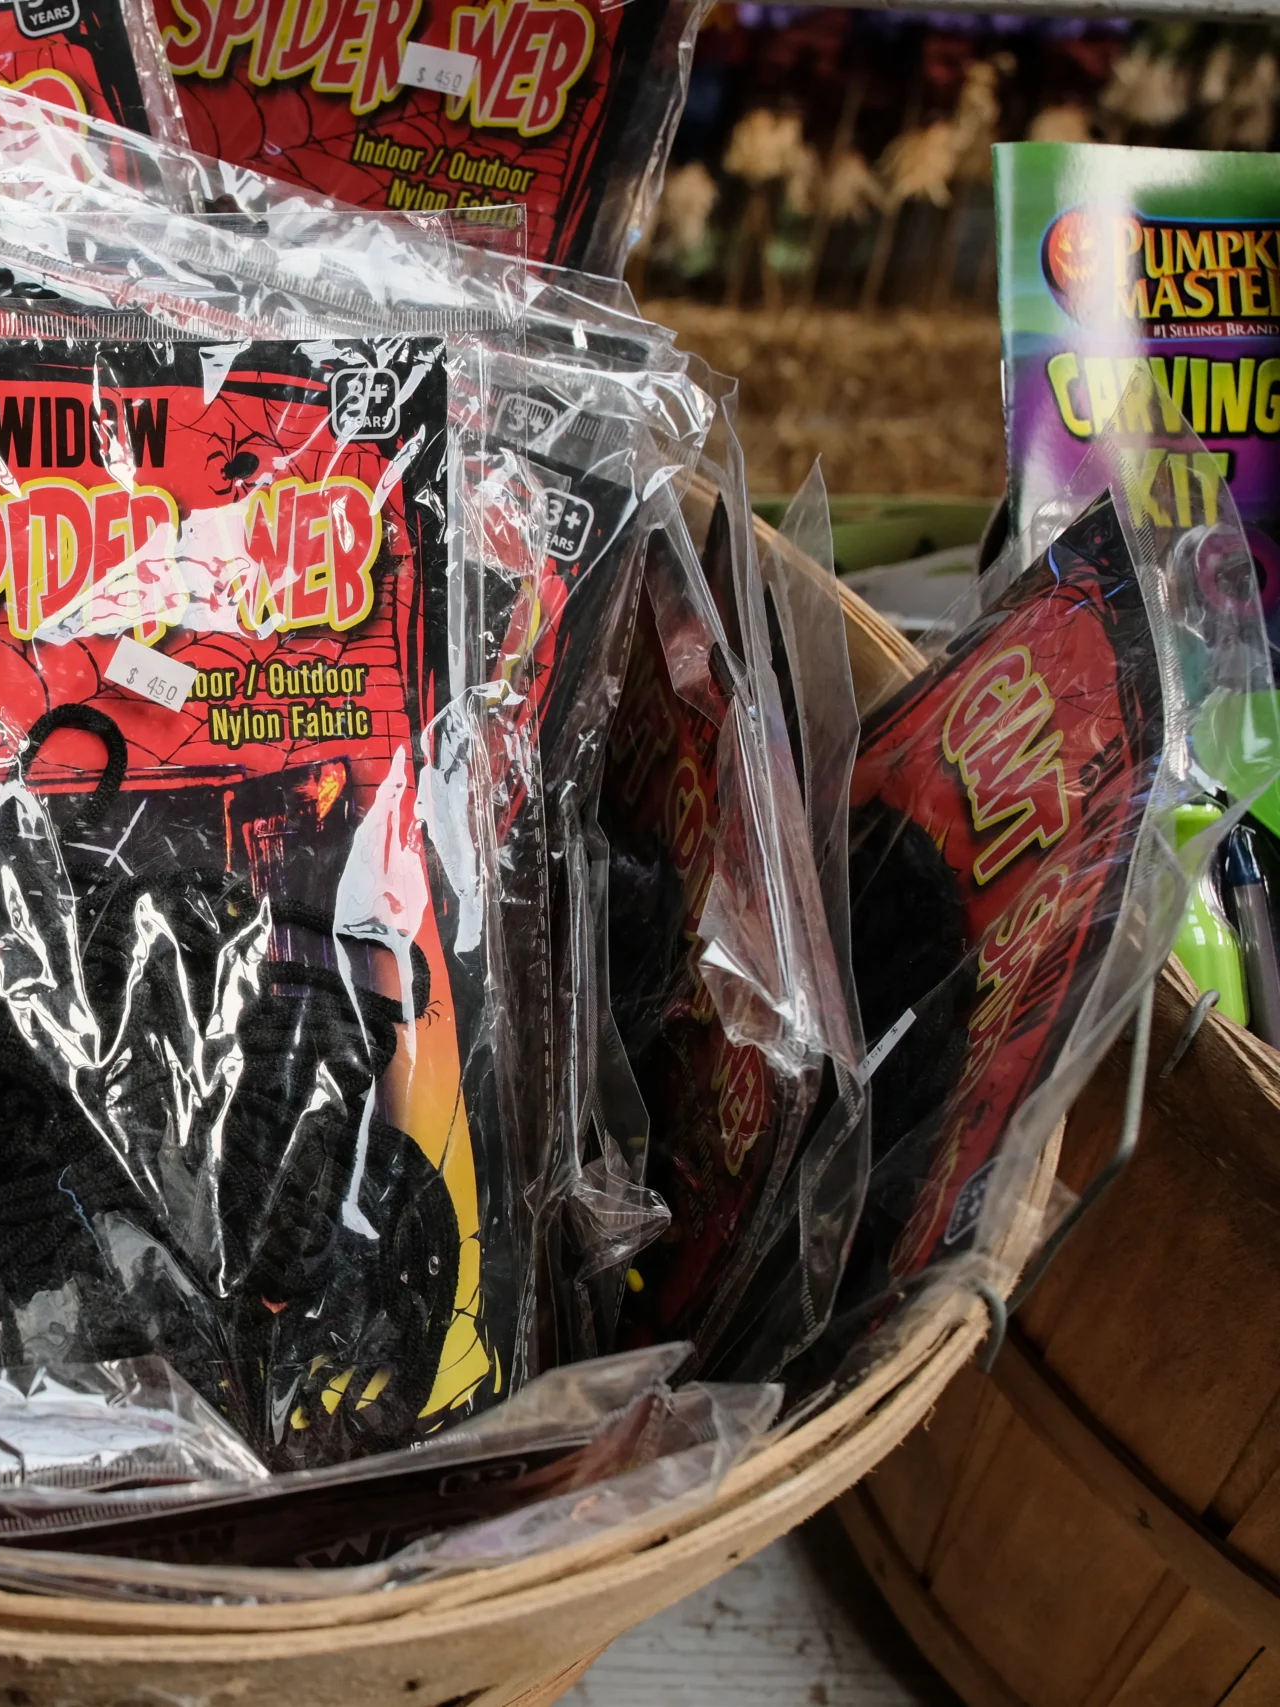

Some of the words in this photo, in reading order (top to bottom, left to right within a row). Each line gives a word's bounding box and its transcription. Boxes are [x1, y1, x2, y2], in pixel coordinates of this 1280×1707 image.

[29, 4, 71, 27] YEARS
[163, 0, 414, 114] SPIDER
[446, 2, 597, 137] WEB
[352, 134, 423, 172] Indoor
[448, 151, 535, 194] Outdoor
[388, 178, 449, 212] Nylon
[1153, 323, 1167, 338] #1
[1047, 352, 1280, 439] CARVING
[1120, 448, 1229, 529] KIT
[214, 476, 384, 637] WEB
[544, 532, 576, 552] EARS
[268, 662, 366, 696] Outdoor
[211, 707, 282, 747] Nylon
[291, 704, 369, 738] Fabric
[942, 645, 1070, 886] GIANT
